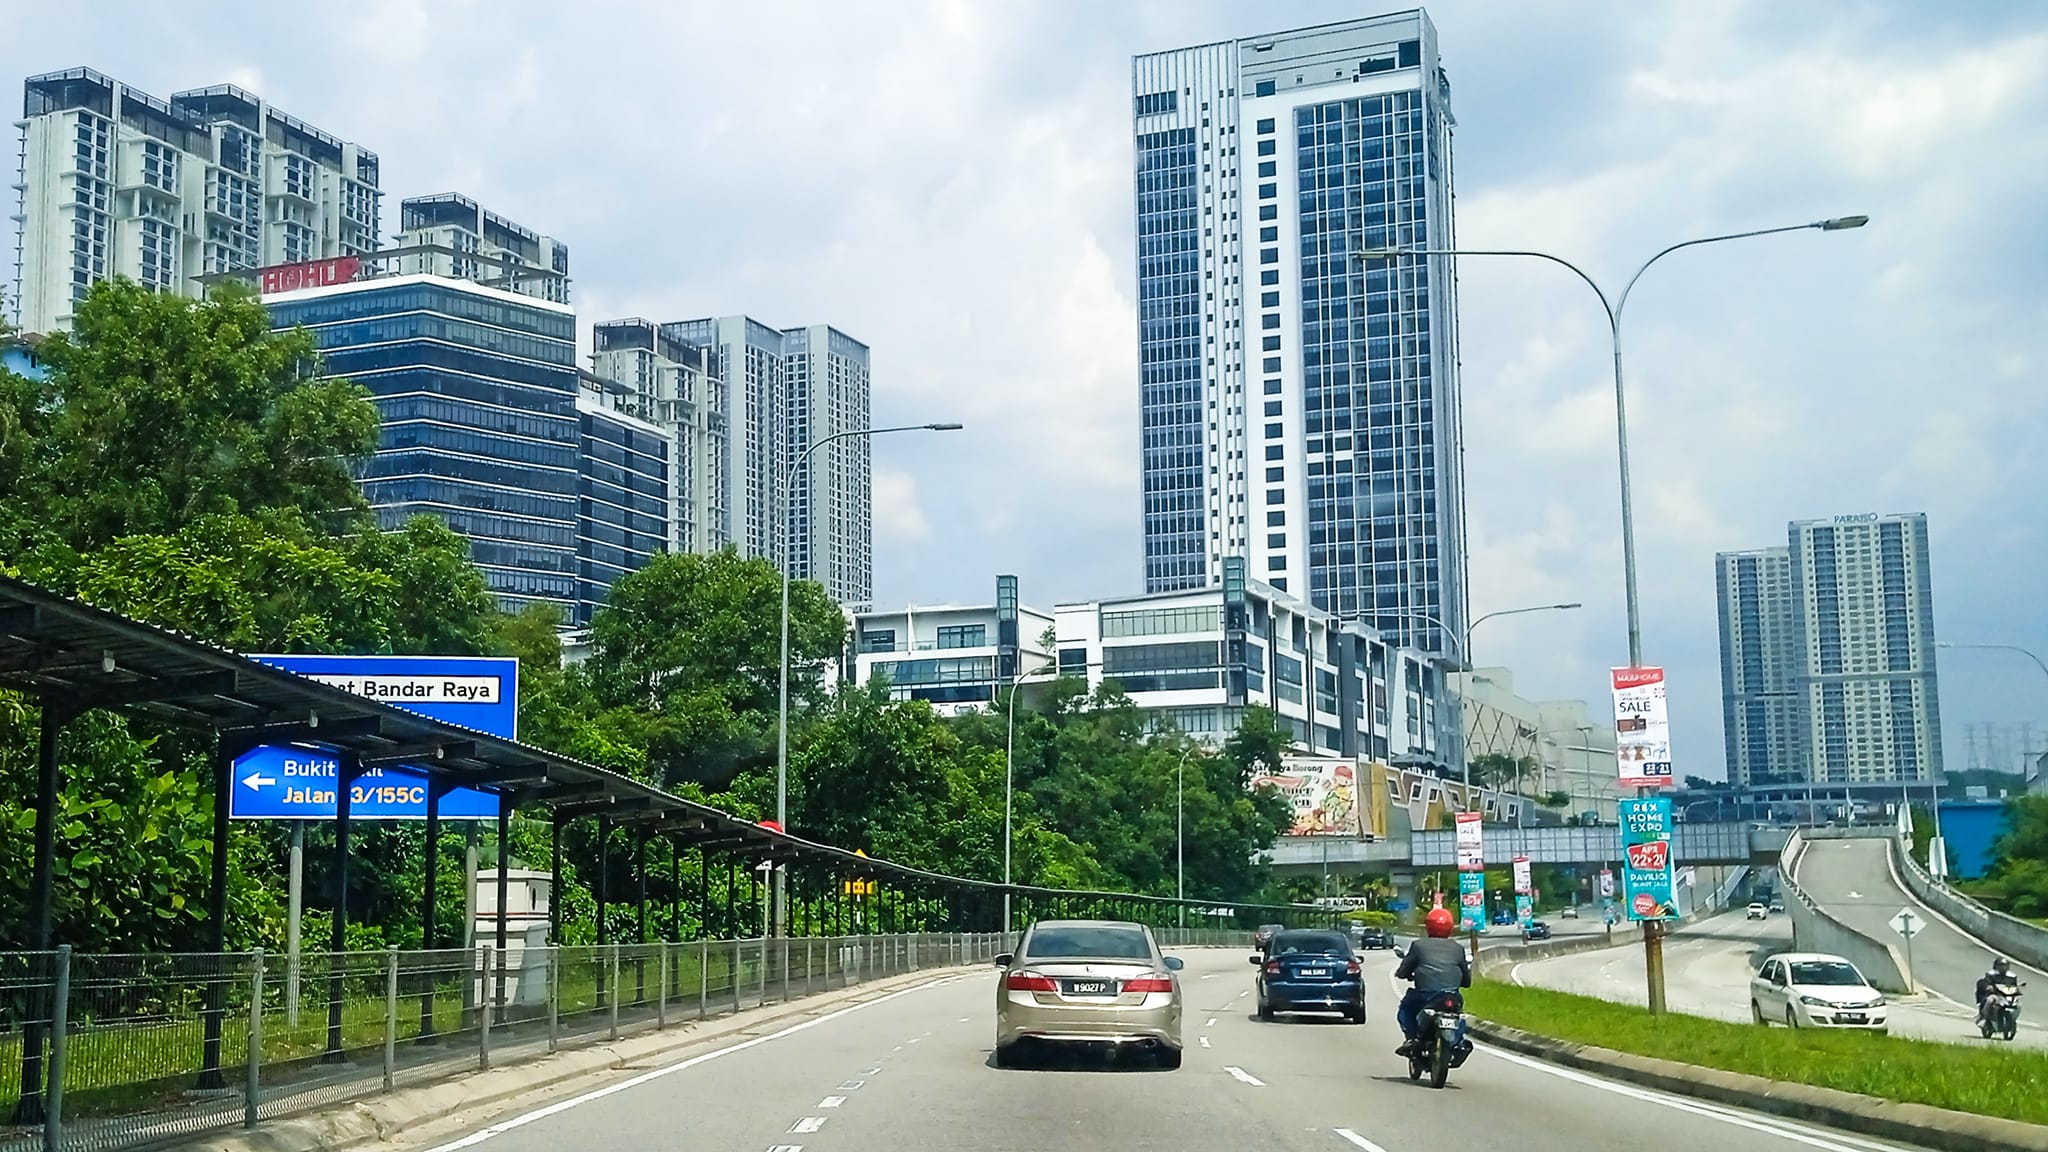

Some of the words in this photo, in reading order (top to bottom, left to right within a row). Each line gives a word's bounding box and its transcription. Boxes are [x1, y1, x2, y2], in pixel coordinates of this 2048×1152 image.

[364, 681, 434, 697] Bandar
[442, 681, 490, 700] Raya
[1619, 701, 1651, 713] SALE
[284, 760, 335, 777] Bukit
[1293, 764, 1323, 773] Borong
[282, 786, 336, 804] Jalan
[1633, 803, 1657, 812] REX
[1627, 813, 1663, 822] HOME
[1631, 823, 1662, 832] EXPO
[1633, 854, 1647, 866] 22
